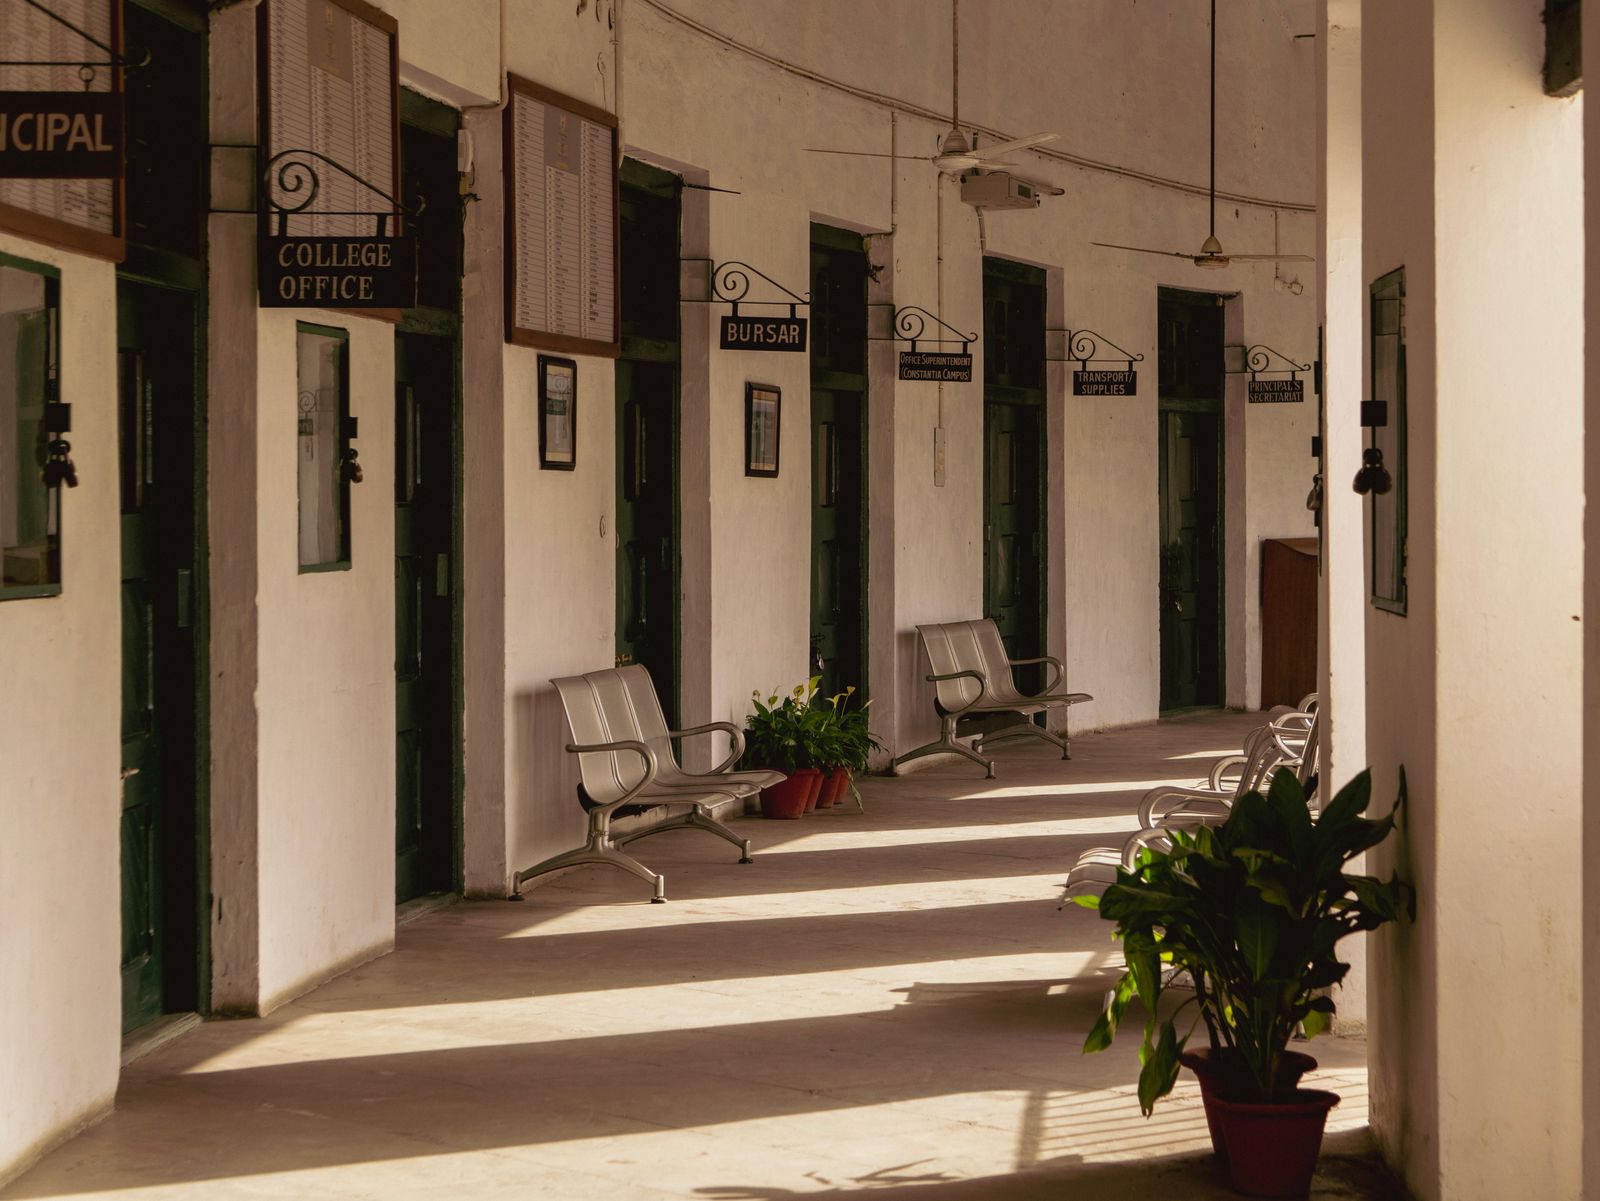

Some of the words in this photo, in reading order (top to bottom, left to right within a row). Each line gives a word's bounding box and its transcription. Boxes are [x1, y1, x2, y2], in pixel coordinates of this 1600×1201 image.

[0, 112, 113, 152] CIPAL
[278, 243, 392, 268] COLLEGE
[279, 275, 374, 300] OFFICE
[727, 322, 800, 344] BURSAR
[900, 353, 921, 364] OFFICE
[921, 353, 971, 366] SUPERINTENDENT
[901, 366, 941, 379] (CONSTANTIA
[942, 368, 970, 382] CAMPUS)
[1078, 371, 1134, 383] TRANSPORT/
[1082, 384, 1125, 395] SUPPLIES
[1249, 391, 1302, 402] SECRETARIAT
